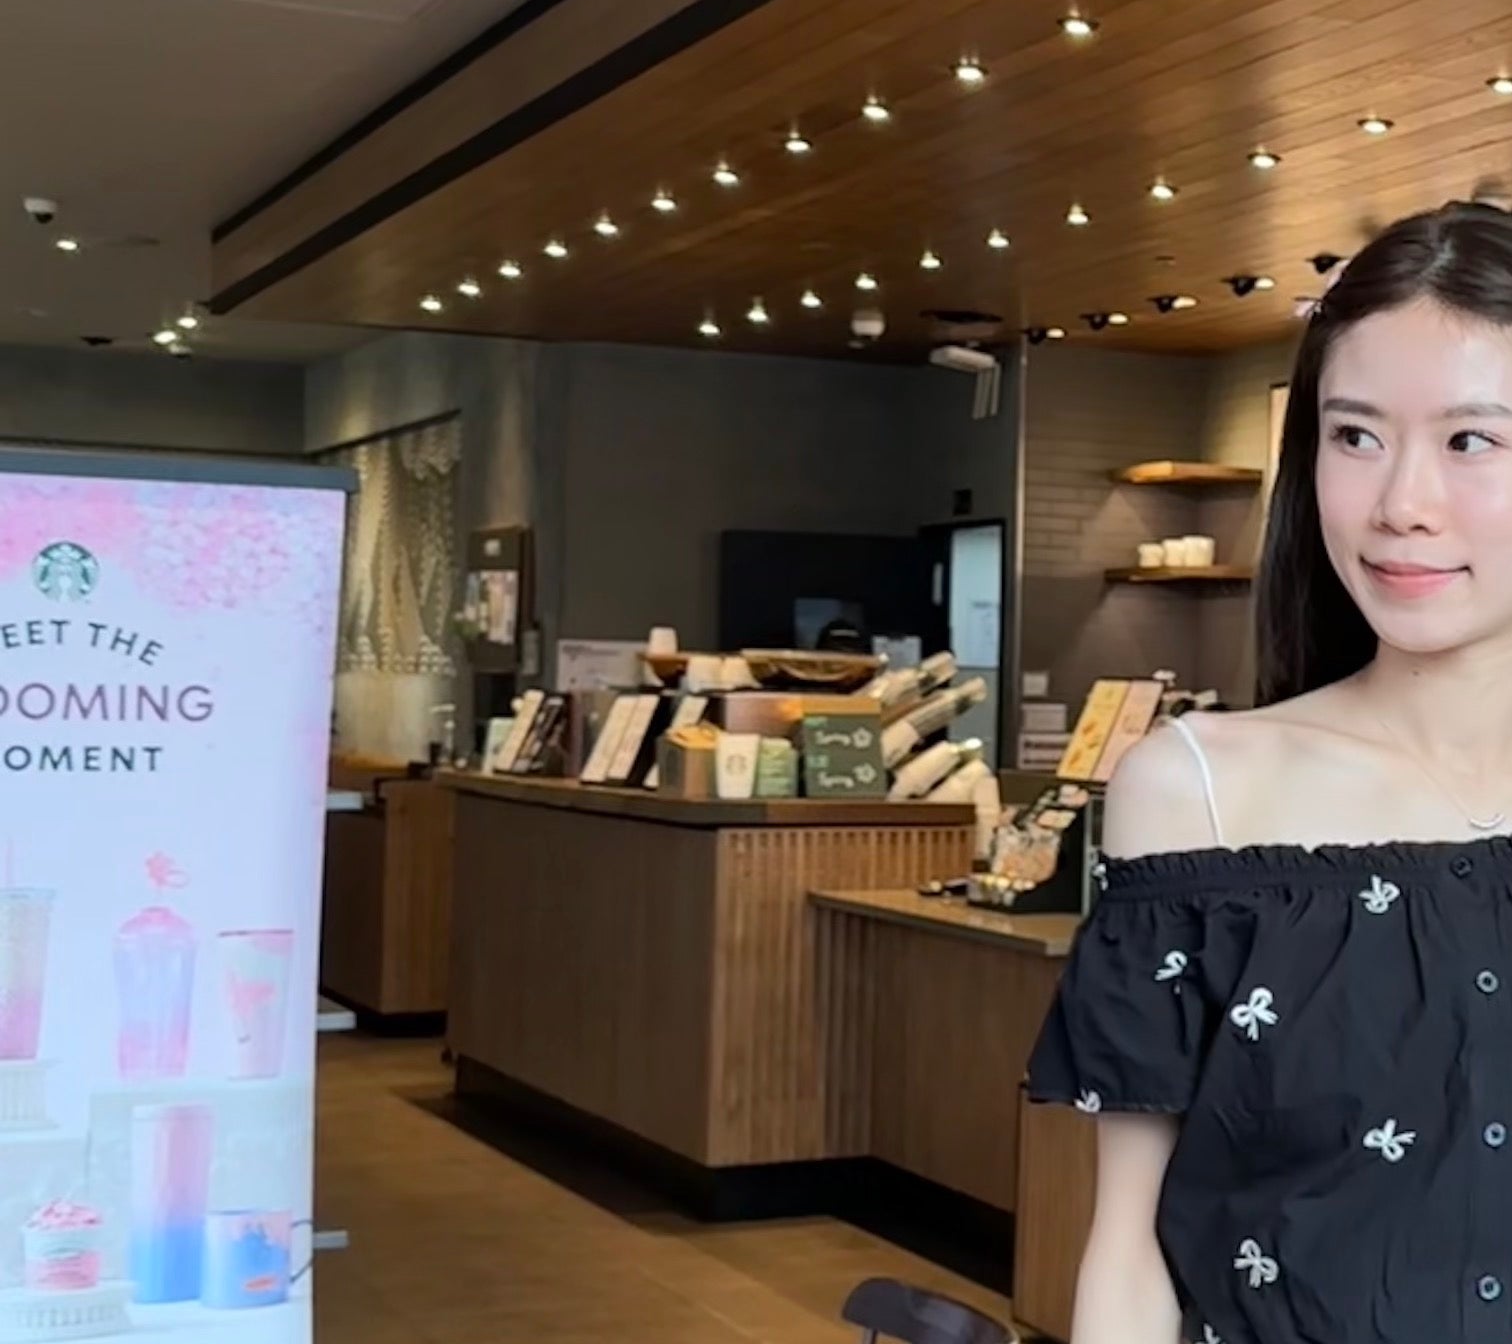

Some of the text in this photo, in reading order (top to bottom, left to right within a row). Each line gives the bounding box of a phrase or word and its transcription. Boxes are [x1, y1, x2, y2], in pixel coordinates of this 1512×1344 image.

[88, 622, 164, 667] THE
[0, 682, 214, 723] OMING
[3, 744, 164, 773] OMENT
